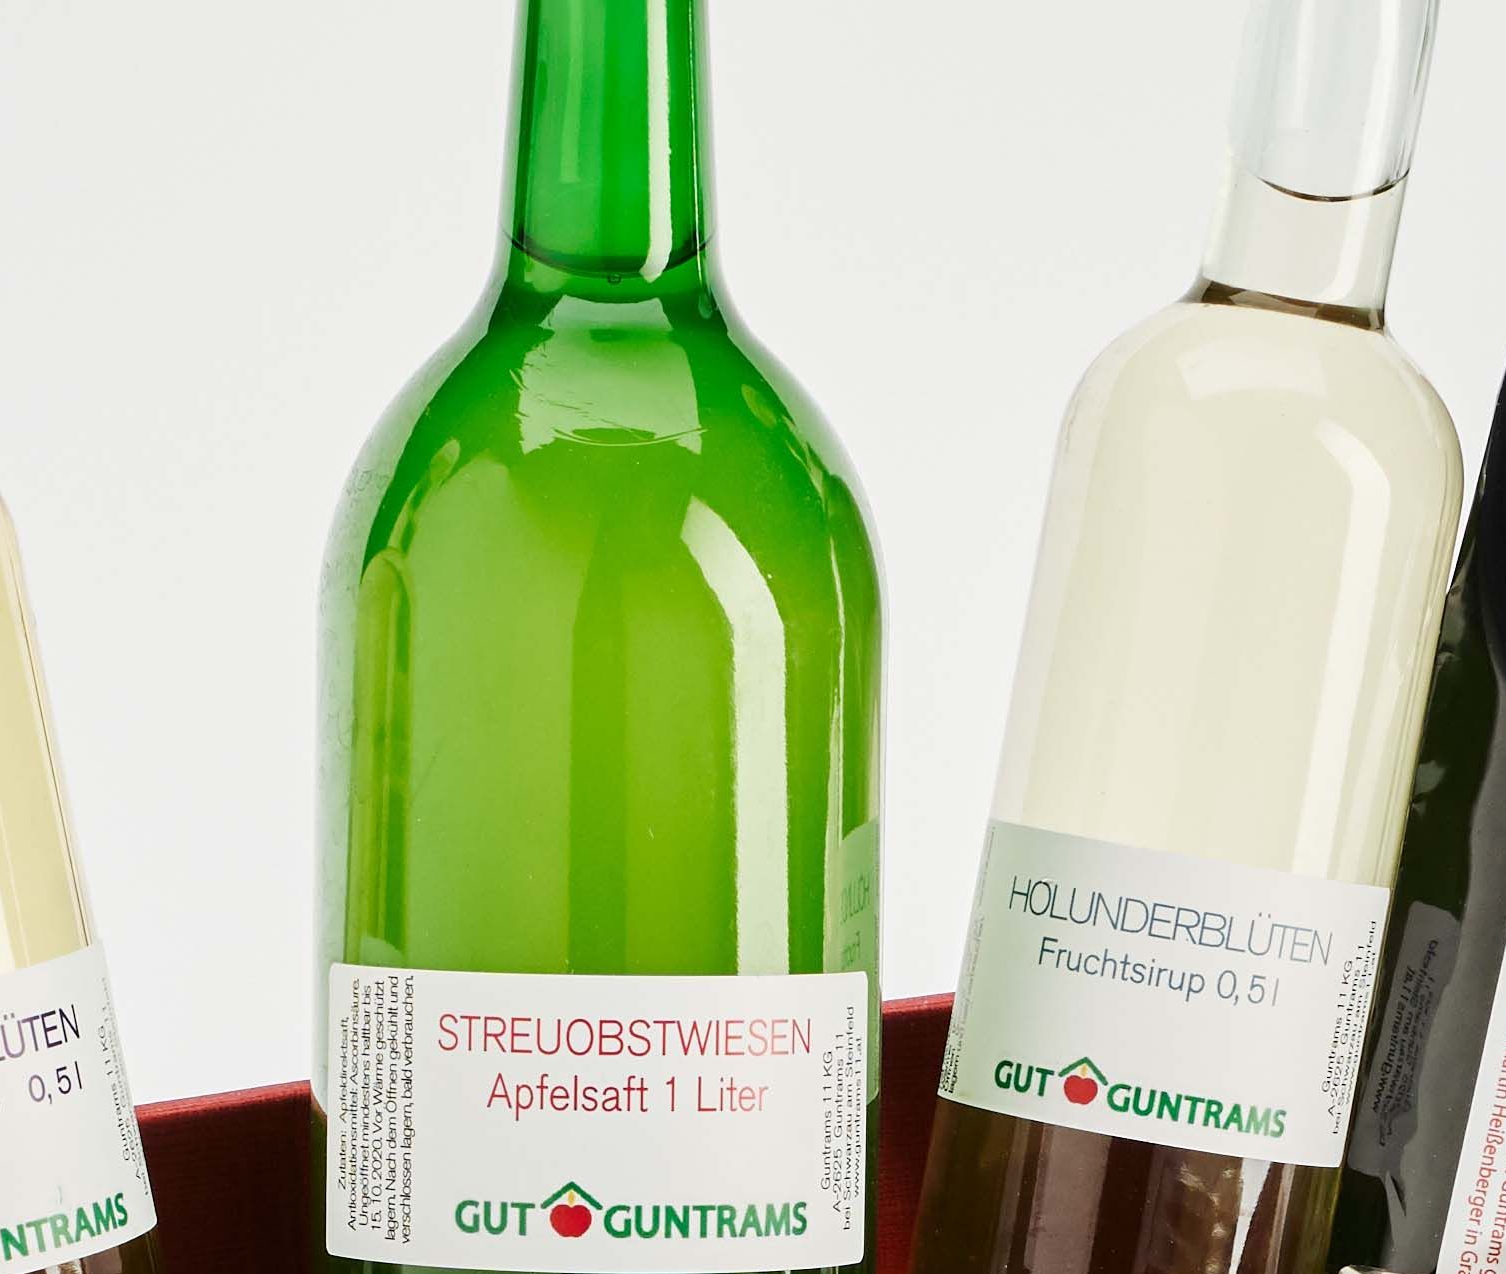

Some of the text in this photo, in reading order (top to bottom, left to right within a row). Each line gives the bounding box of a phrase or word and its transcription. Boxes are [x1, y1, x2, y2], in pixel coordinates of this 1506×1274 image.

[1009, 875, 1333, 966] HOLUNDERBLÜTEN
[1038, 937, 1206, 1000] Fruchtsirup
[401, 974, 414, 1066] verbrauchen.
[438, 1013, 812, 1057] STREUOBSTWIESEN
[400, 1068, 413, 1098] bald
[822, 1050, 833, 1077] KG
[487, 1072, 768, 1121] Apfelsaft 1 Liter
[994, 1060, 1287, 1139] GUT GUNTRAMS
[820, 1109, 832, 1189] Guntrams
[399, 1151, 412, 1244] verschlossen
[455, 1200, 808, 1239] GUT GUNTRAMS
[1463, 1228, 1482, 1246] in
